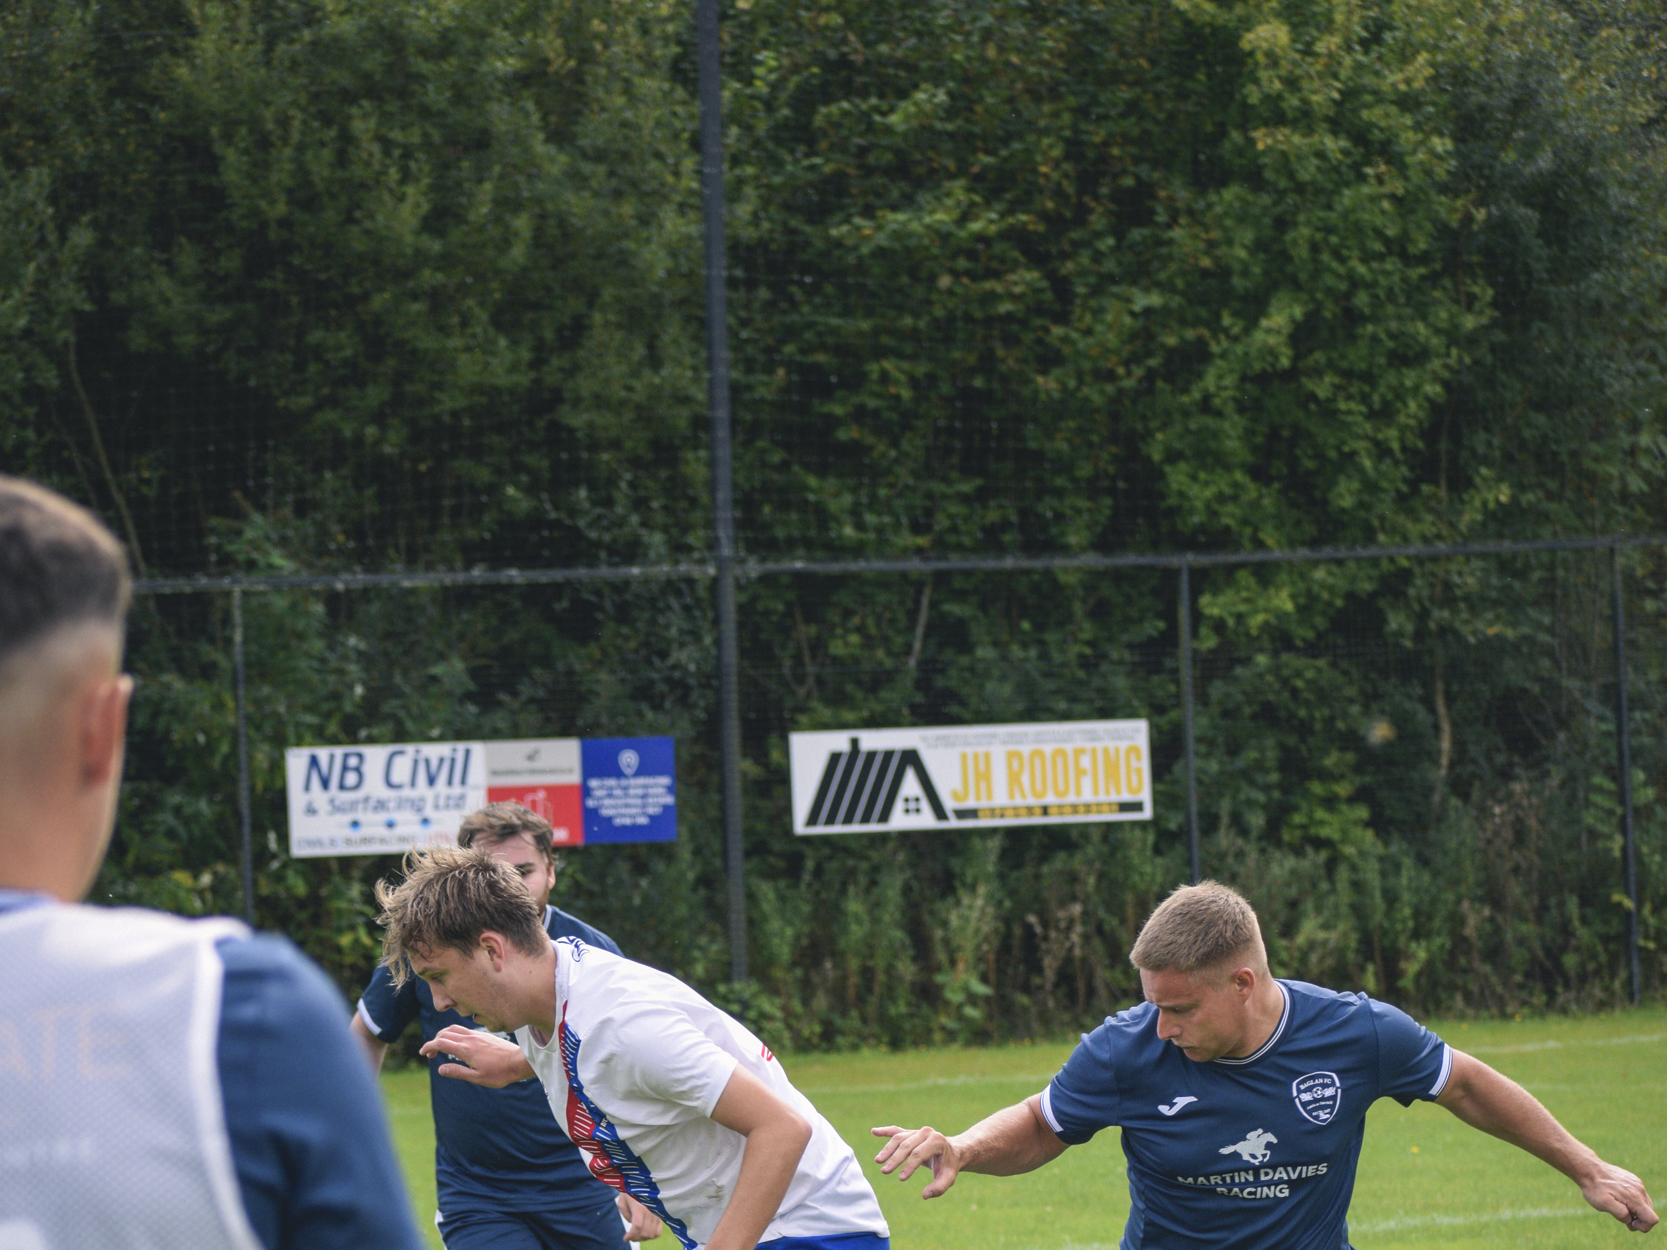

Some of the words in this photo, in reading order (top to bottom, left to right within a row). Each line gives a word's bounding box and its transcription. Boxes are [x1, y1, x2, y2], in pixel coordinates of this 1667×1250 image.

[305, 752, 365, 792] NB
[385, 748, 472, 789] Civil
[951, 751, 994, 803] JH
[1006, 744, 1144, 801] ROOFING
[328, 795, 426, 815] Surfacing
[433, 792, 467, 811] Ltd
[1177, 1169, 1254, 1185] MARTIN
[1260, 1163, 1328, 1181] DAVIES
[1216, 1184, 1290, 1199] RACING
